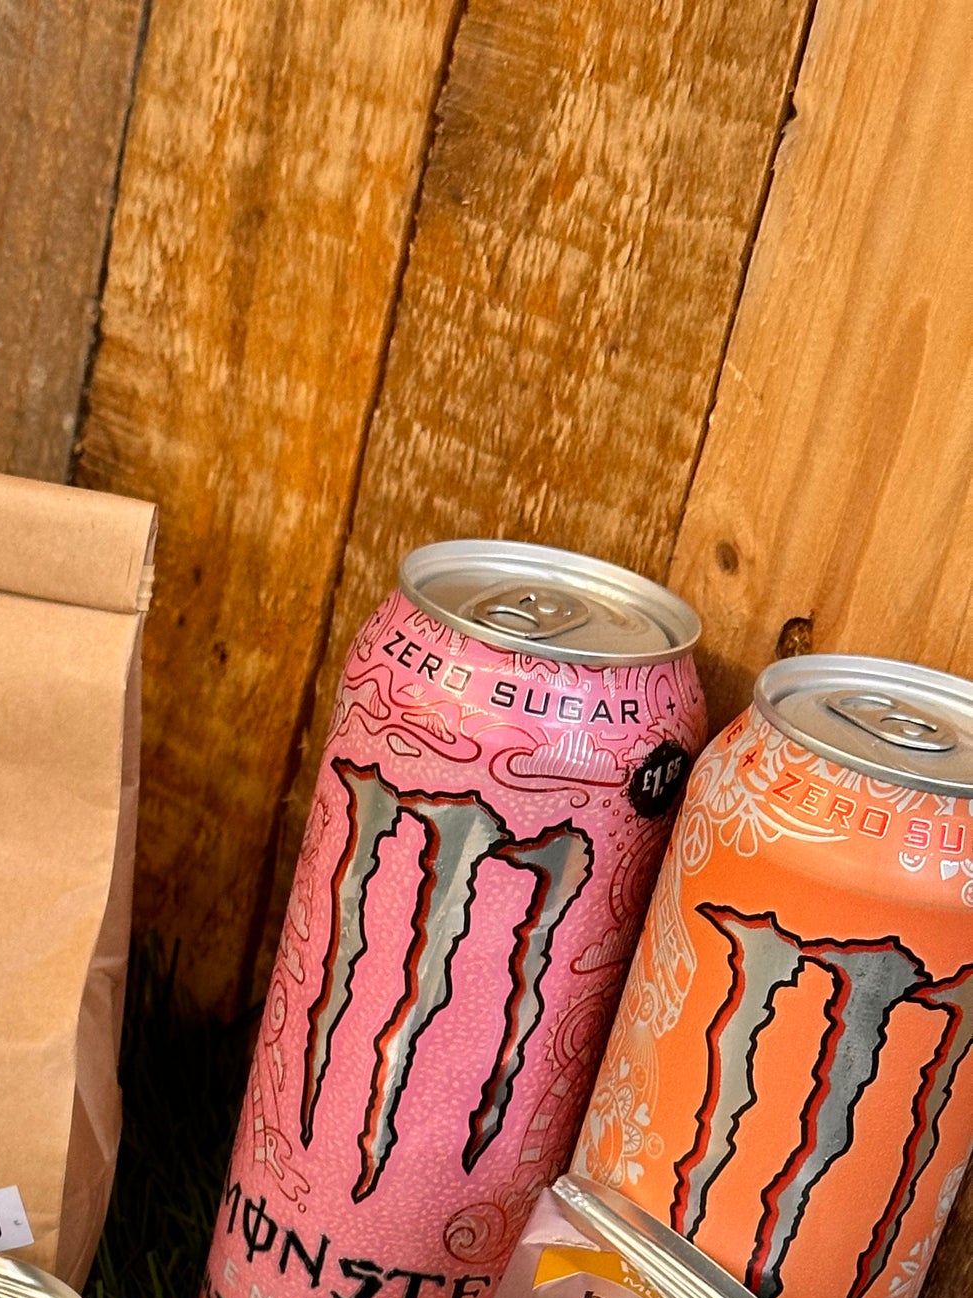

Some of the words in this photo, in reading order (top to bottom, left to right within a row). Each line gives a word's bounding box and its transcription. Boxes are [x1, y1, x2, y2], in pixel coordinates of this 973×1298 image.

[382, 630, 472, 695] ZERO
[490, 681, 640, 725] SUGAR
[771, 771, 892, 840] ZERO
[903, 817, 973, 855] SU
